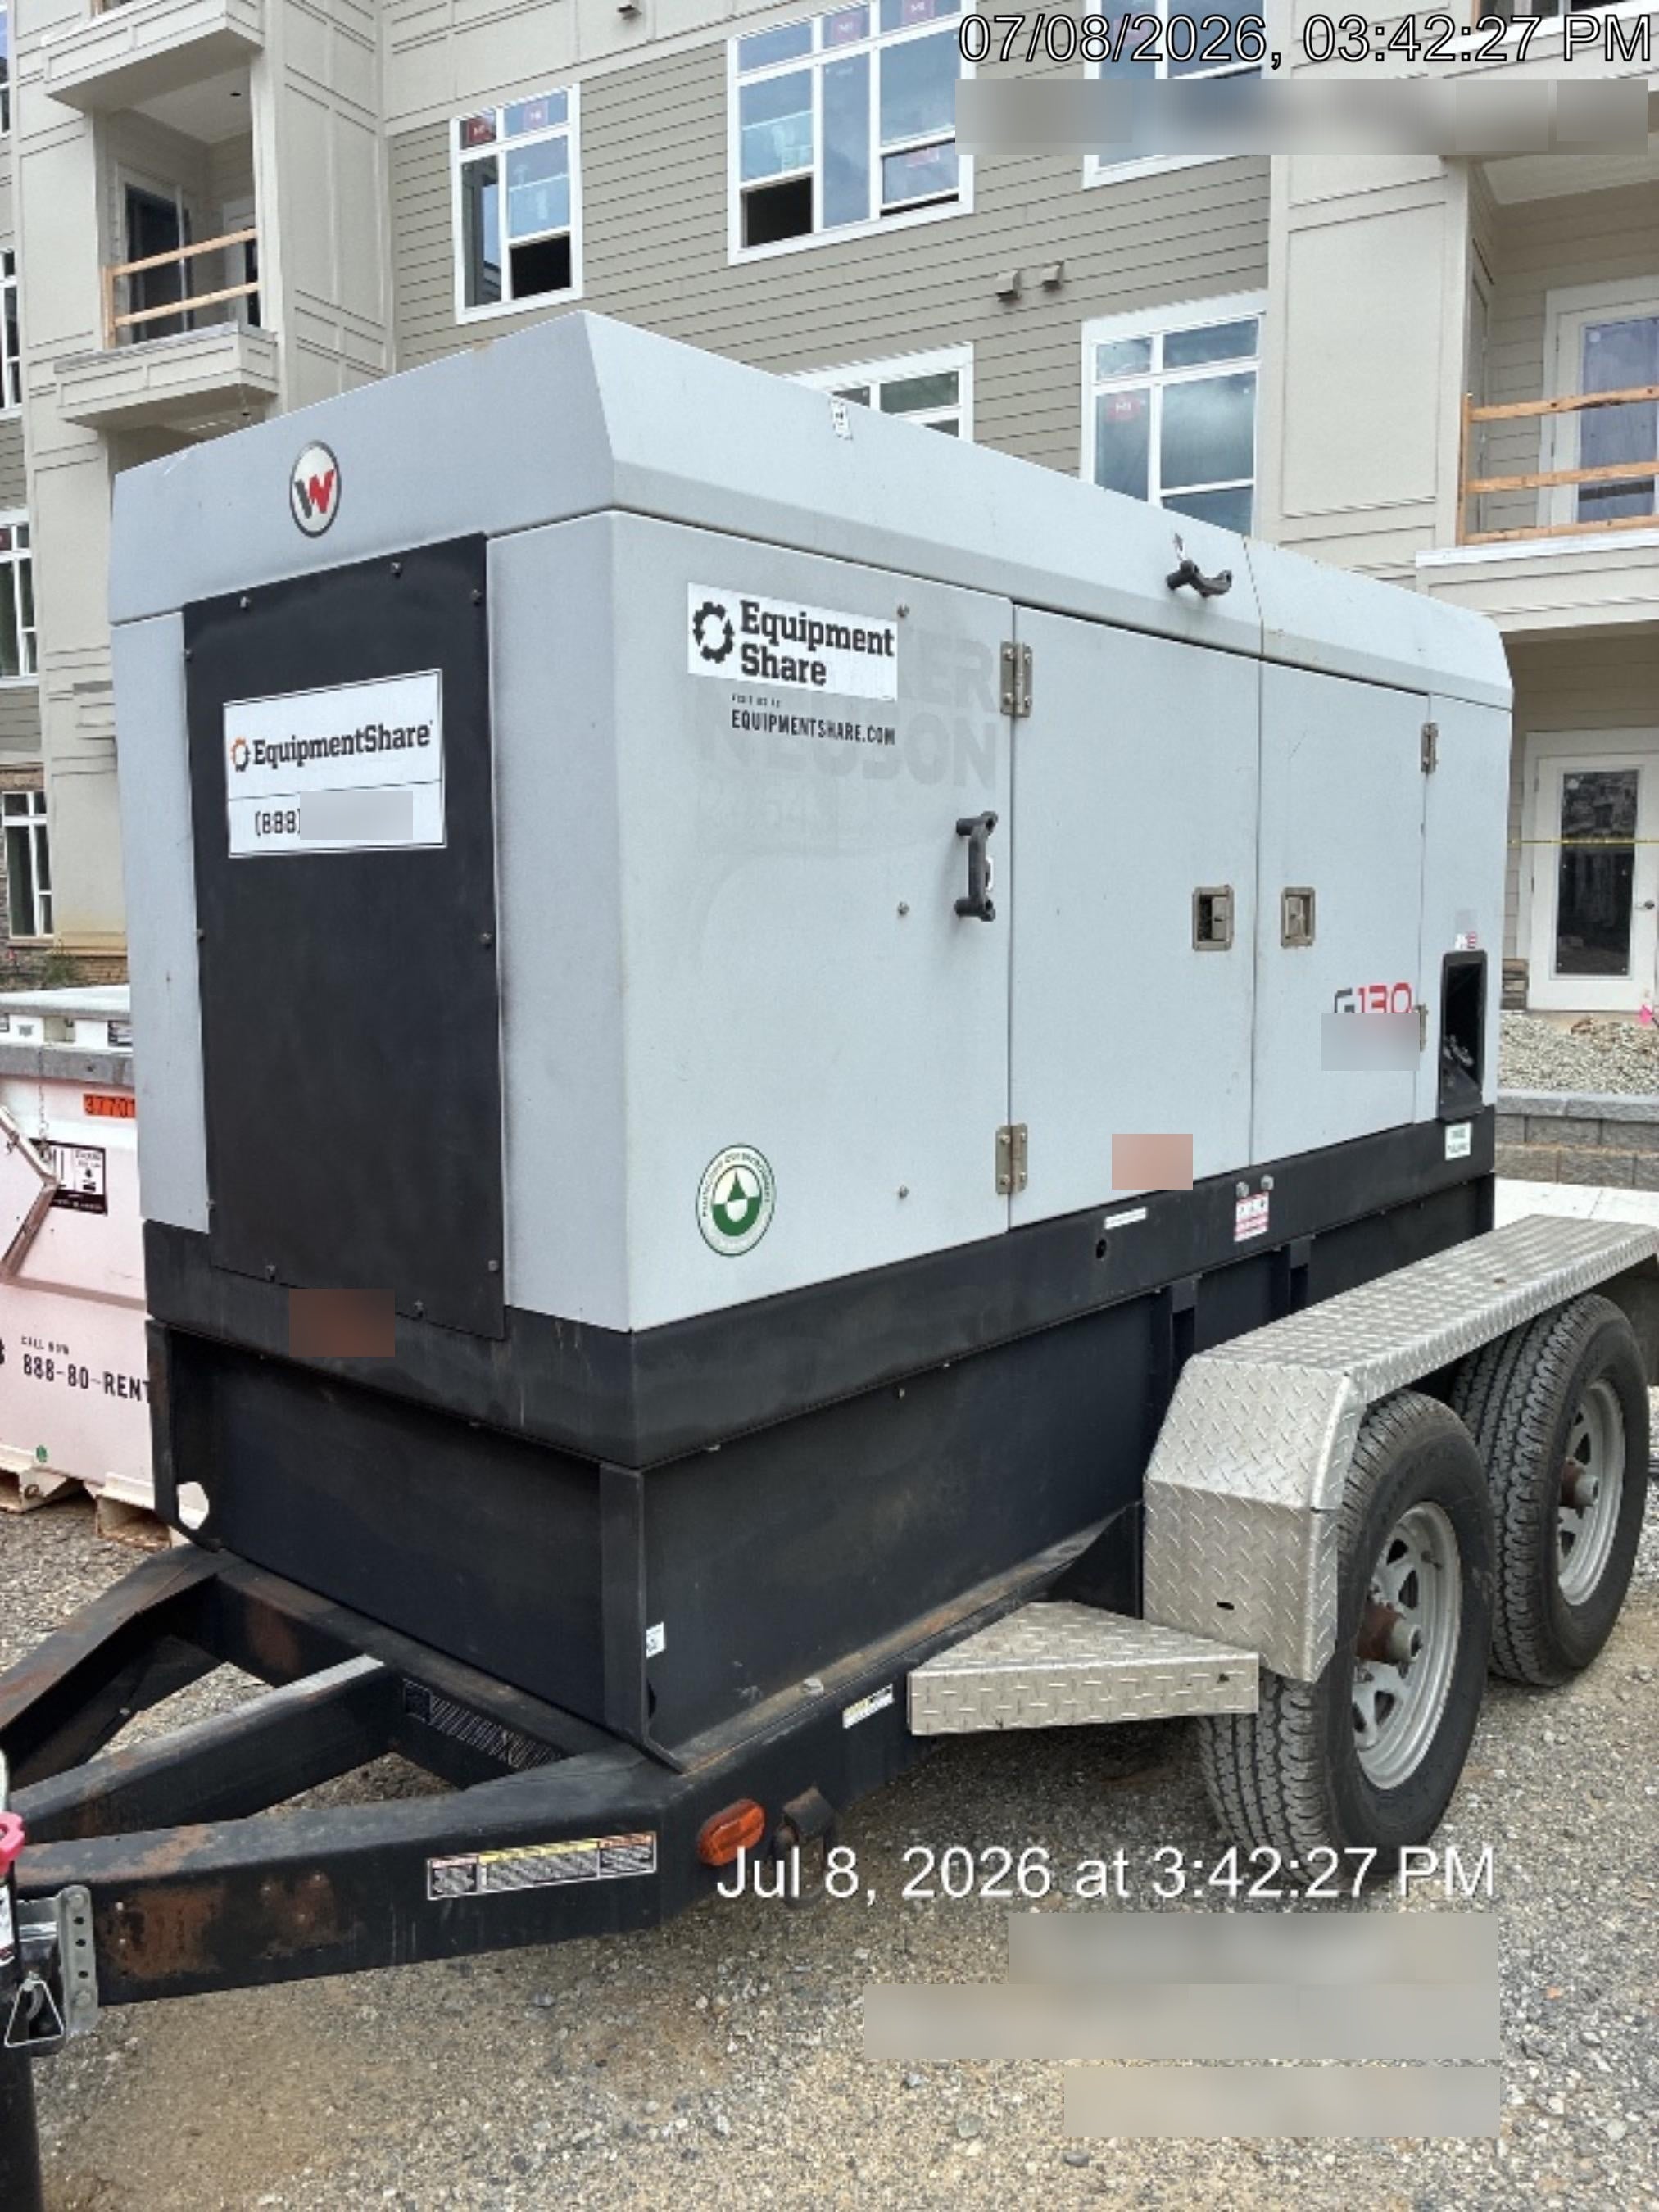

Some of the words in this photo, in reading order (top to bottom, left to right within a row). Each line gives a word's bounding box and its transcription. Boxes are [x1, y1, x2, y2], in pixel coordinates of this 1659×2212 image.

[740, 599, 895, 656] Equipment
[741, 643, 827, 686] Share
[253, 723, 430, 769] EquipmentShare
[732, 709, 895, 745] EQUIPMENTSHARE.COM
